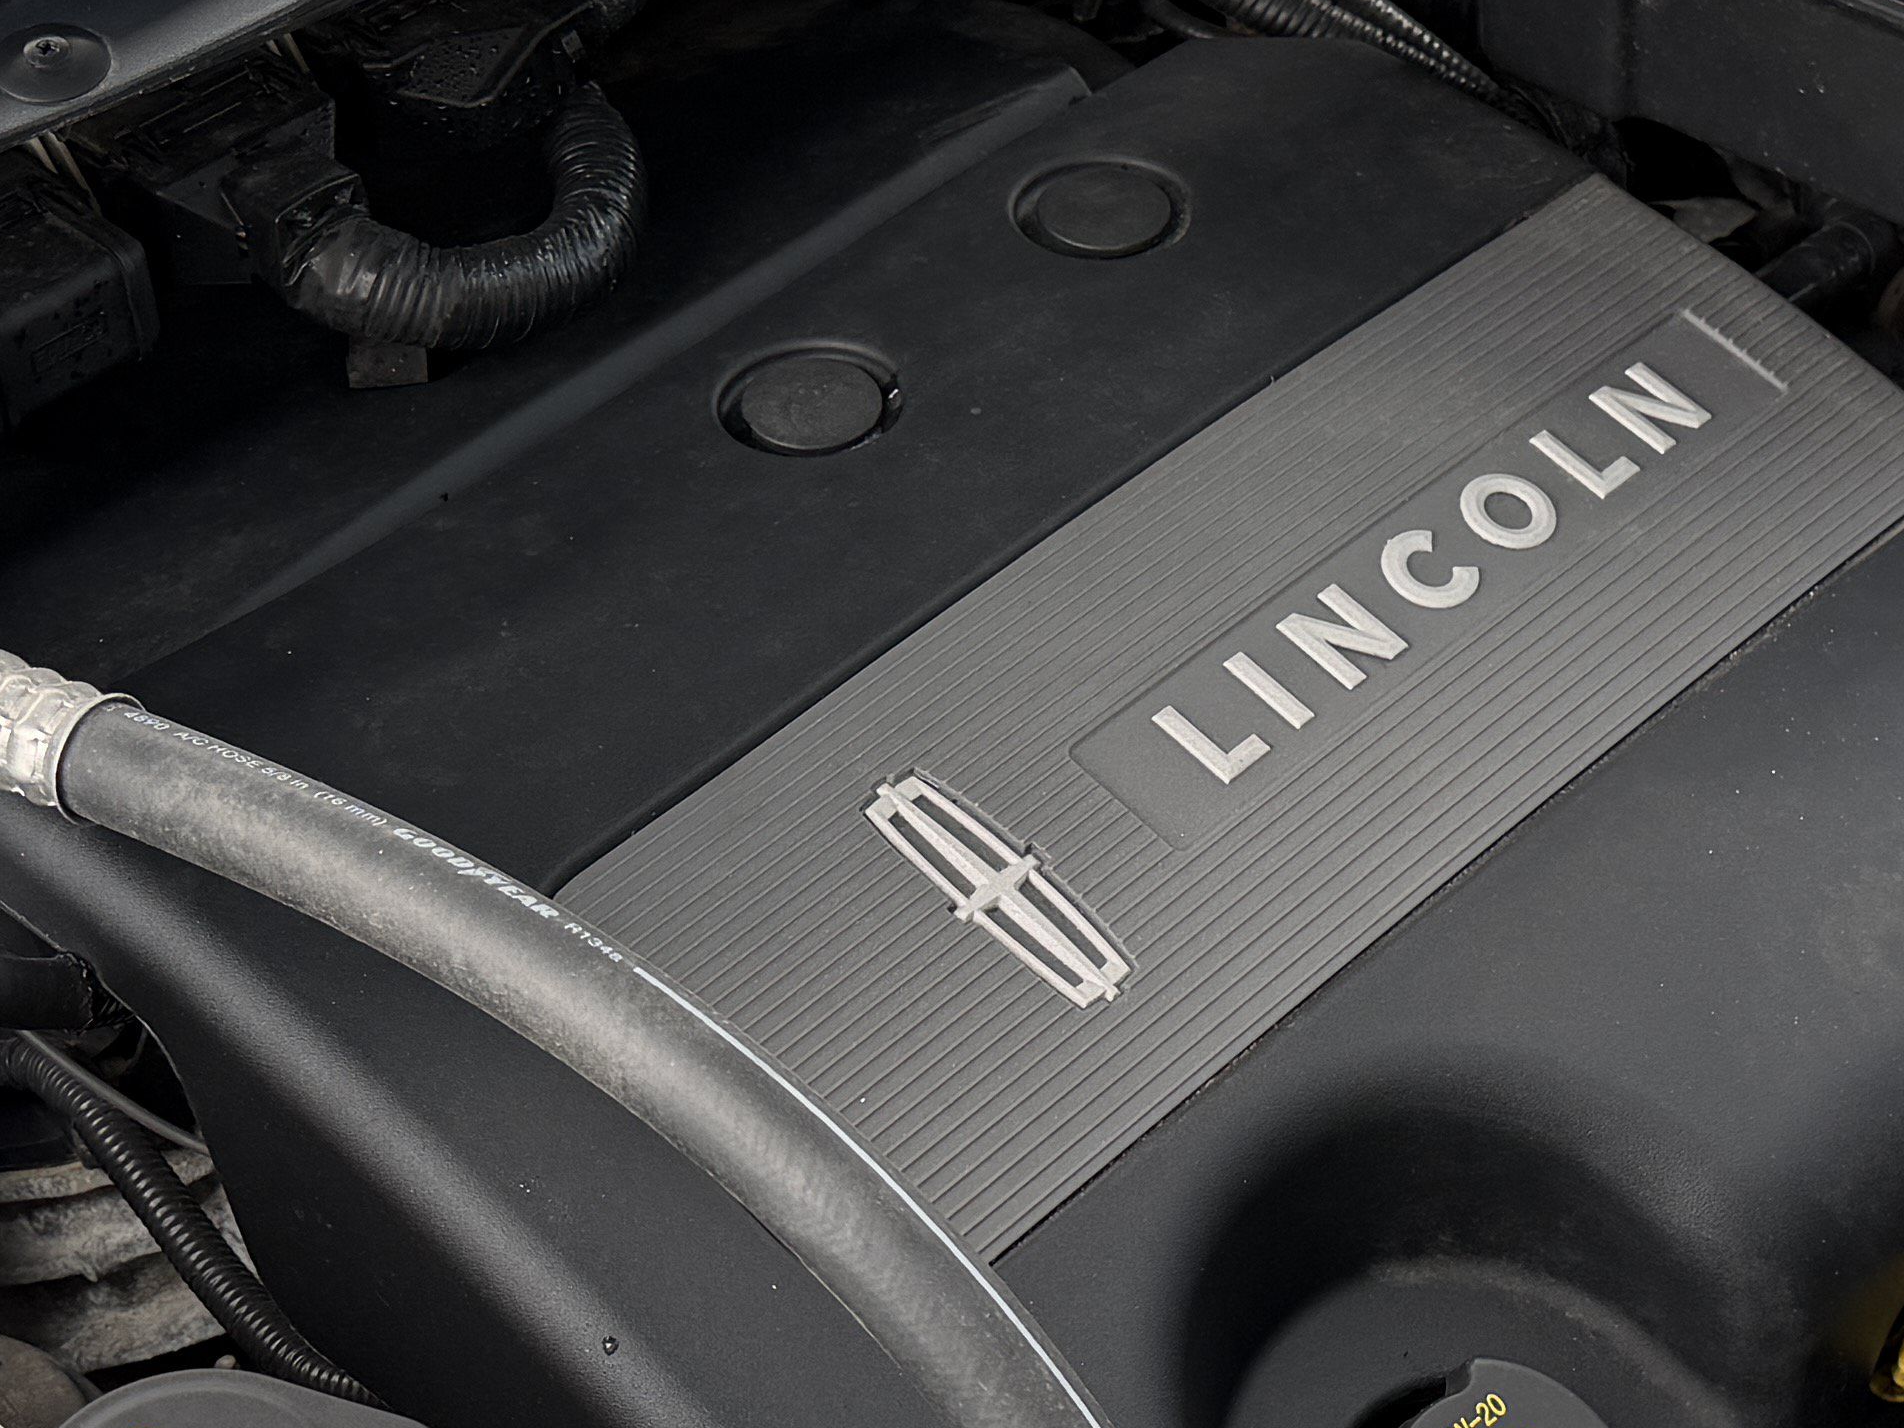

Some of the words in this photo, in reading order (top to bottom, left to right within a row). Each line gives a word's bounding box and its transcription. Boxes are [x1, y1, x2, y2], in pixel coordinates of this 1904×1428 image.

[1152, 363, 1711, 784] LINCOLN
[209, 743, 261, 769] HOSE
[344, 802, 388, 827] mm)
[393, 826, 561, 919] GOODYEAR
